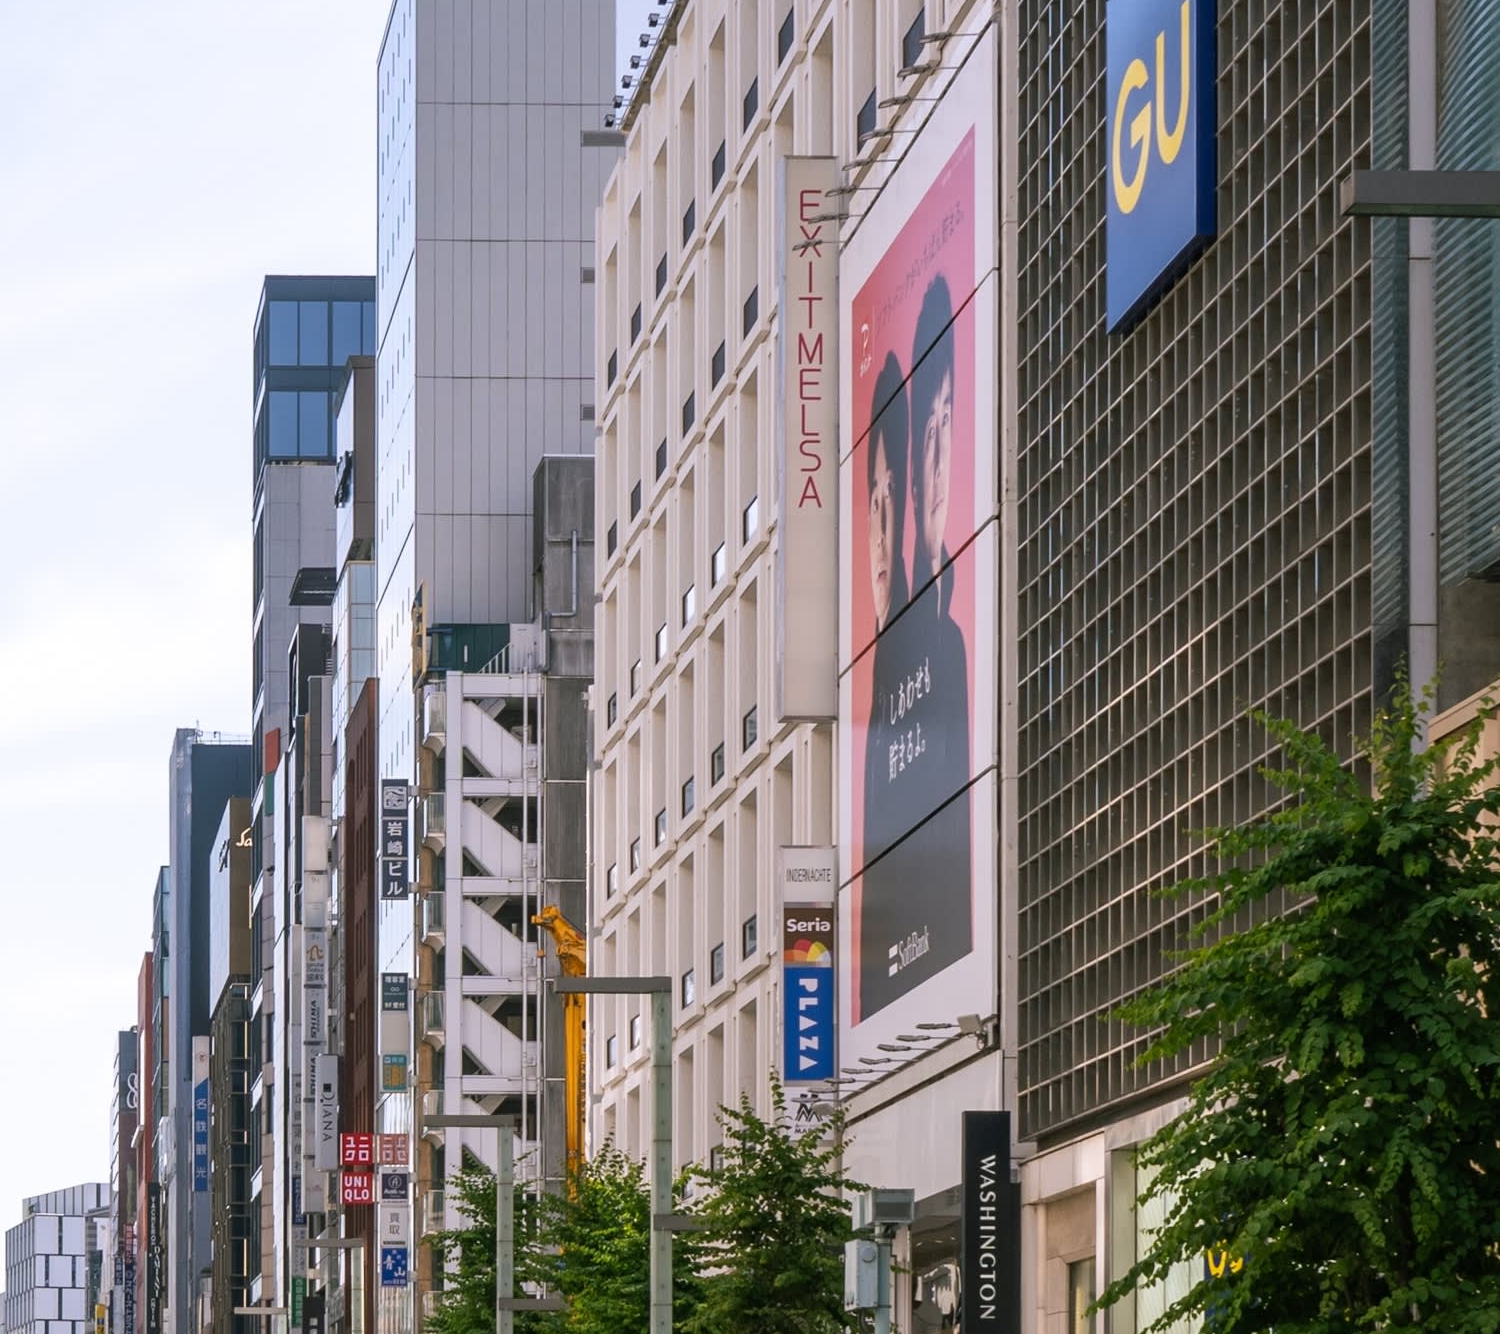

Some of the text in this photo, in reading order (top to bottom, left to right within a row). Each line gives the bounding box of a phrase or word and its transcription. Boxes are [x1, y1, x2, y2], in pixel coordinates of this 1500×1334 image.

[888, 662, 931, 725] しあわせも
[888, 725, 927, 783] 貯まるよ。
[386, 820, 402, 896] 岩崎ビル
[786, 917, 831, 933] Seria
[898, 925, 930, 970] SoftBank
[798, 977, 819, 1072] PLAZA
[195, 1096, 209, 1180] 名鉄観光
[320, 1091, 336, 1144] DIANA
[344, 1136, 369, 1148] ユニ
[344, 1149, 369, 1161] クロ
[344, 1174, 369, 1187] UNI
[344, 1188, 369, 1201] QLO
[979, 1154, 996, 1323] WASHINGTON
